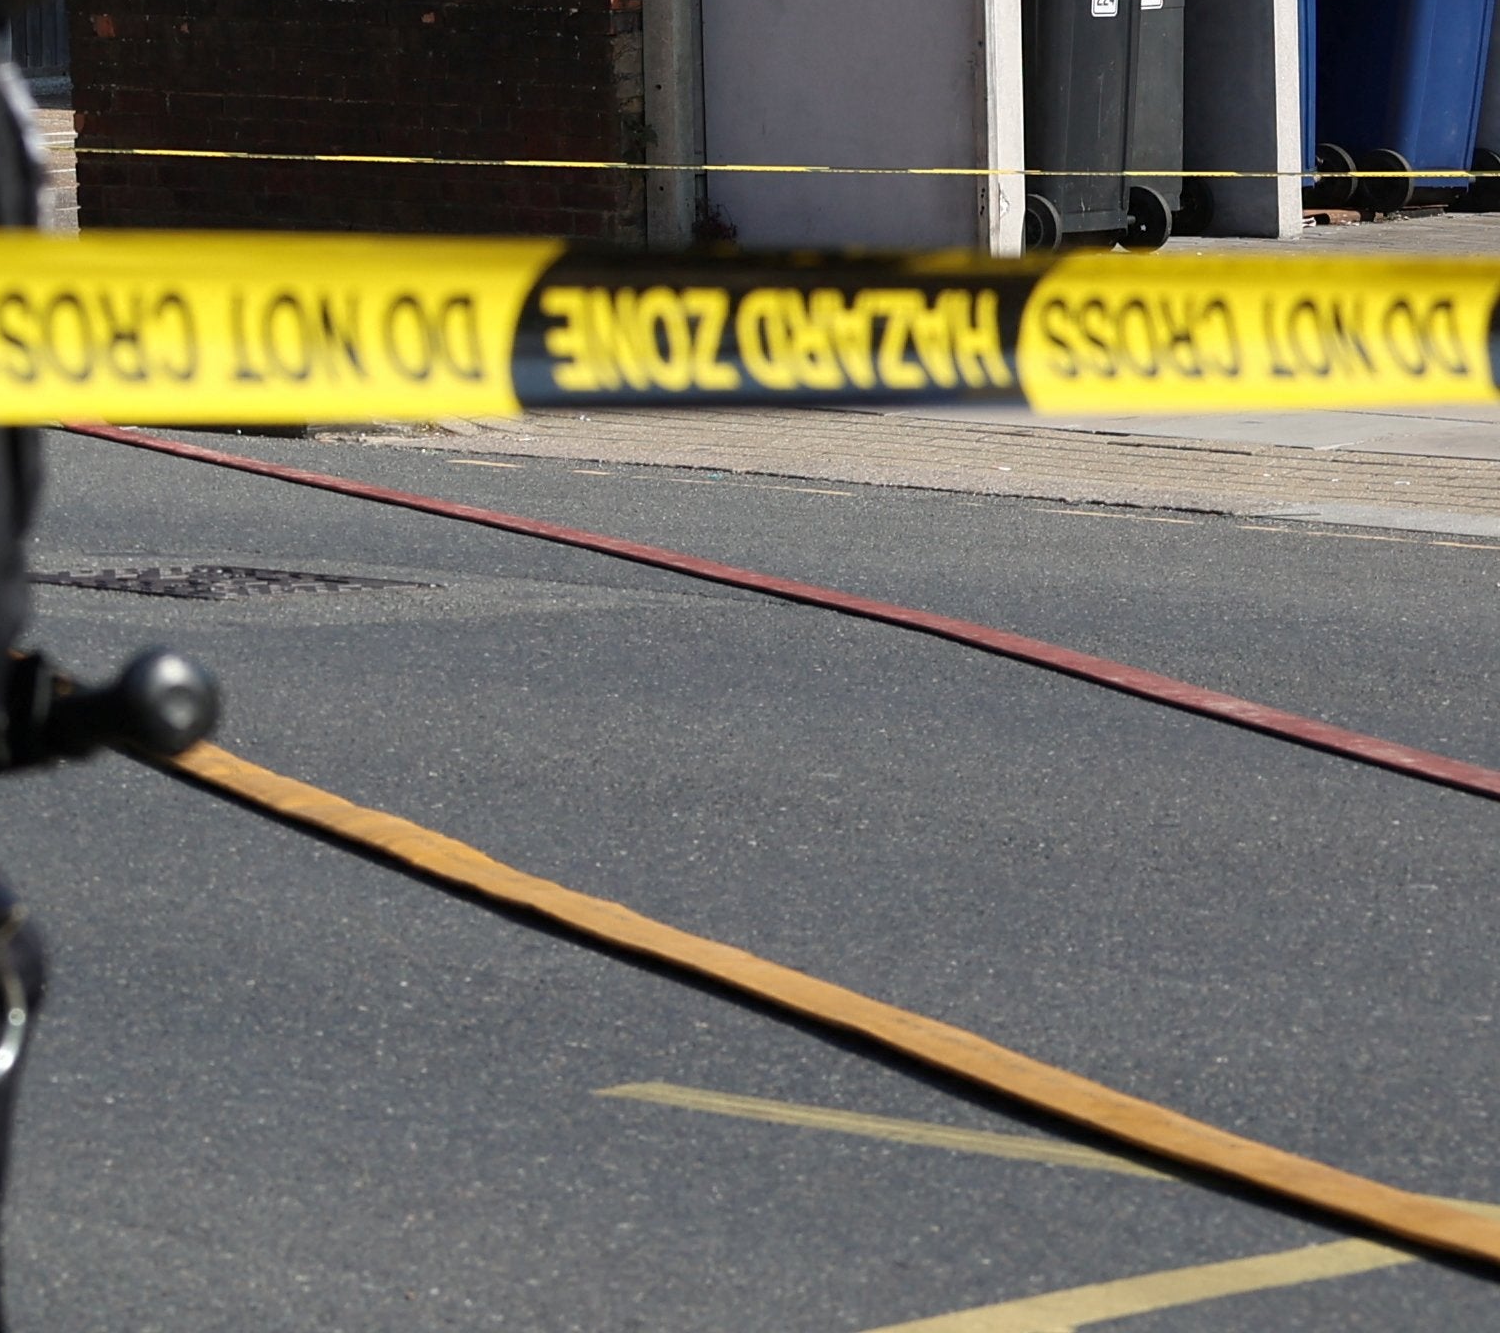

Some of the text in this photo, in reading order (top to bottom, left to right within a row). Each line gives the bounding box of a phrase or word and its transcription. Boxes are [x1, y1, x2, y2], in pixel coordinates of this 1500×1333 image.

[226, 288, 369, 383] NOT
[382, 291, 486, 382] DO
[538, 286, 1012, 393] HAZARD ZONE
[1041, 296, 1470, 380] DO NOT CROSS
